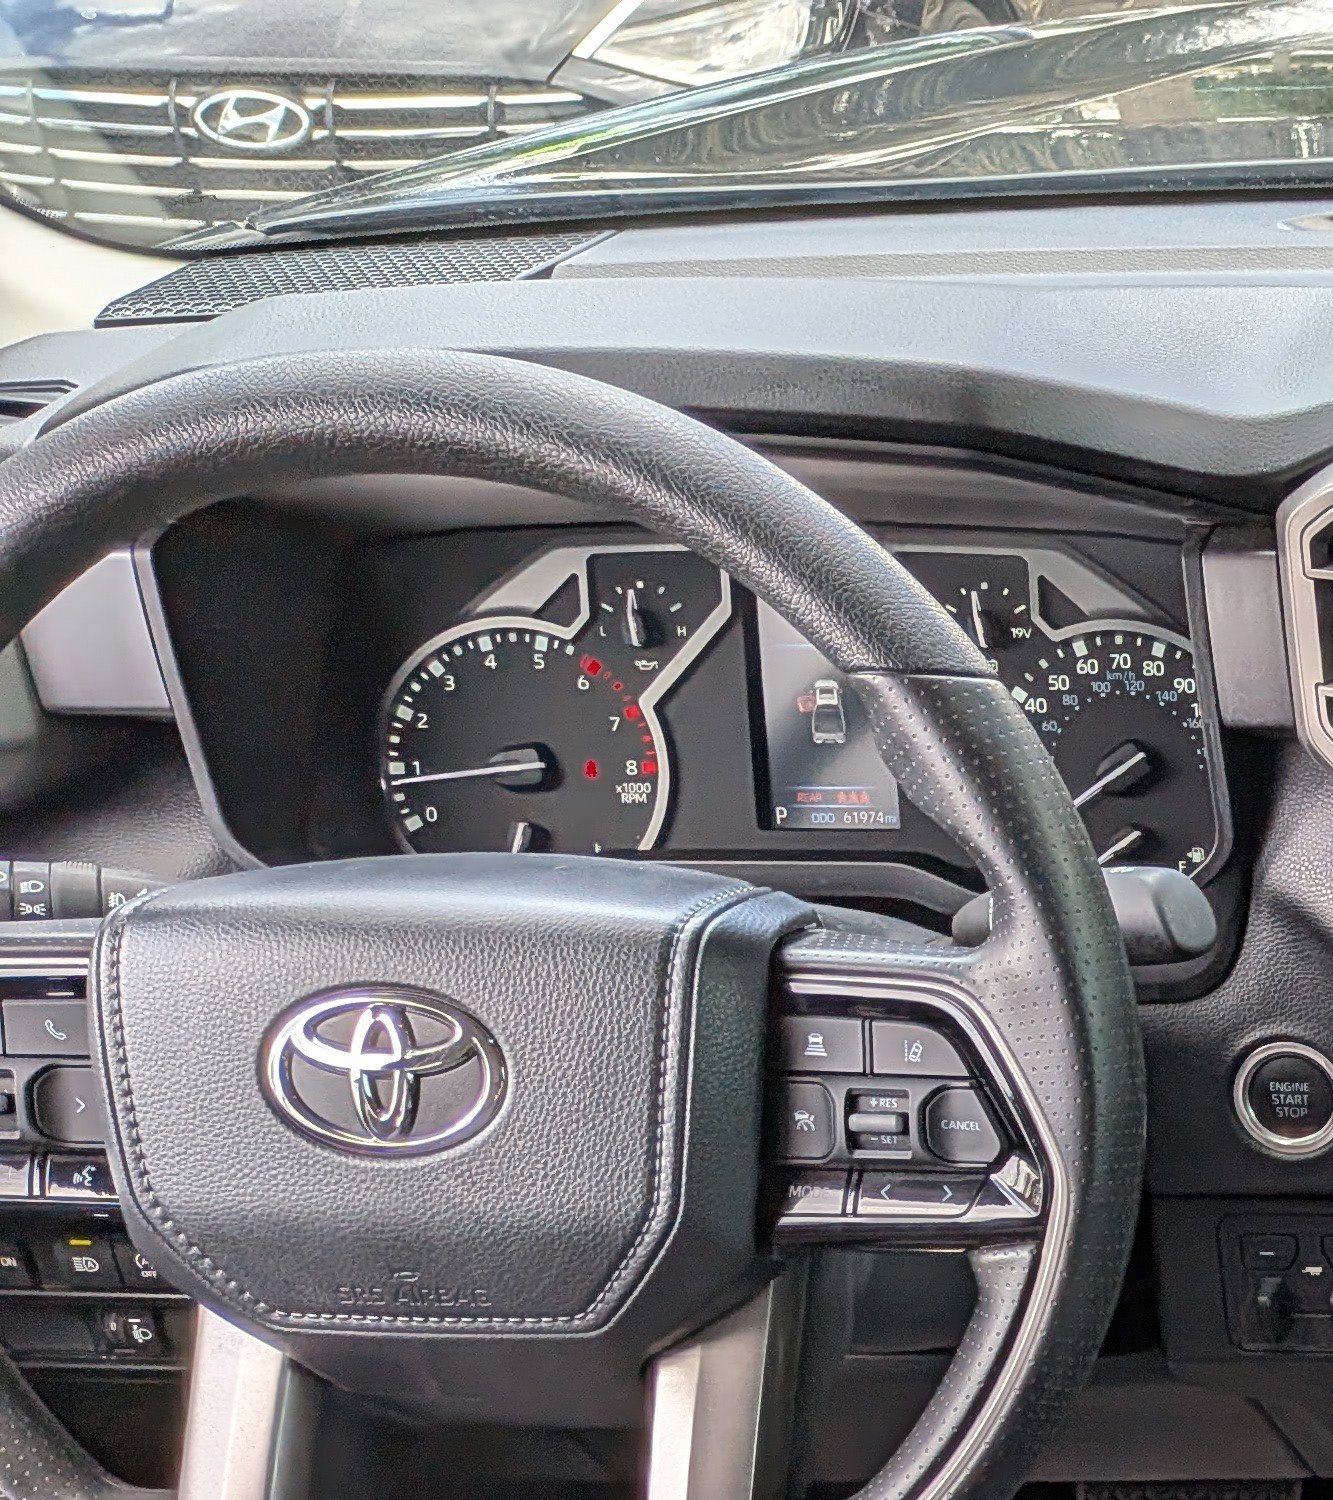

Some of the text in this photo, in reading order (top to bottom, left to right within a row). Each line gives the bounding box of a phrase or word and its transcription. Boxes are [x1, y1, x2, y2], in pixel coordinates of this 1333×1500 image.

[677, 625, 687, 637] H
[1010, 627, 1032, 639] 19V
[484, 653, 497, 670] 4
[533, 653, 545, 669] 5
[1076, 658, 1099, 675] 60
[1109, 653, 1131, 669] 70
[1142, 660, 1165, 677] 80
[443, 675, 455, 691] 3
[577, 674, 590, 690] 6
[1048, 674, 1070, 691] 50
[1106, 669, 1136, 682] km/h
[1091, 681, 1111, 693] 100
[1125, 680, 1145, 692] 120
[1173, 678, 1196, 694] 90
[1062, 694, 1079, 706] 80
[1155, 690, 1178, 702] 140
[1024, 697, 1048, 714] 40
[417, 713, 429, 729] 2
[609, 716, 620, 731] 7
[1041, 721, 1058, 732] 60
[412, 760, 420, 774] 1
[625, 759, 638, 776] 8
[615, 783, 652, 794] x1000
[621, 793, 648, 804] RPM
[425, 806, 438, 821] 0
[775, 806, 788, 824] P
[811, 813, 836, 823] ODO
[843, 811, 884, 824] 61974
[1269, 1081, 1310, 1092] ENGINE
[1271, 1093, 1309, 1105] START
[1275, 1107, 1308, 1118] STOP
[940, 1119, 981, 1131] CANCEL
[788, 1184, 832, 1199] MODE
